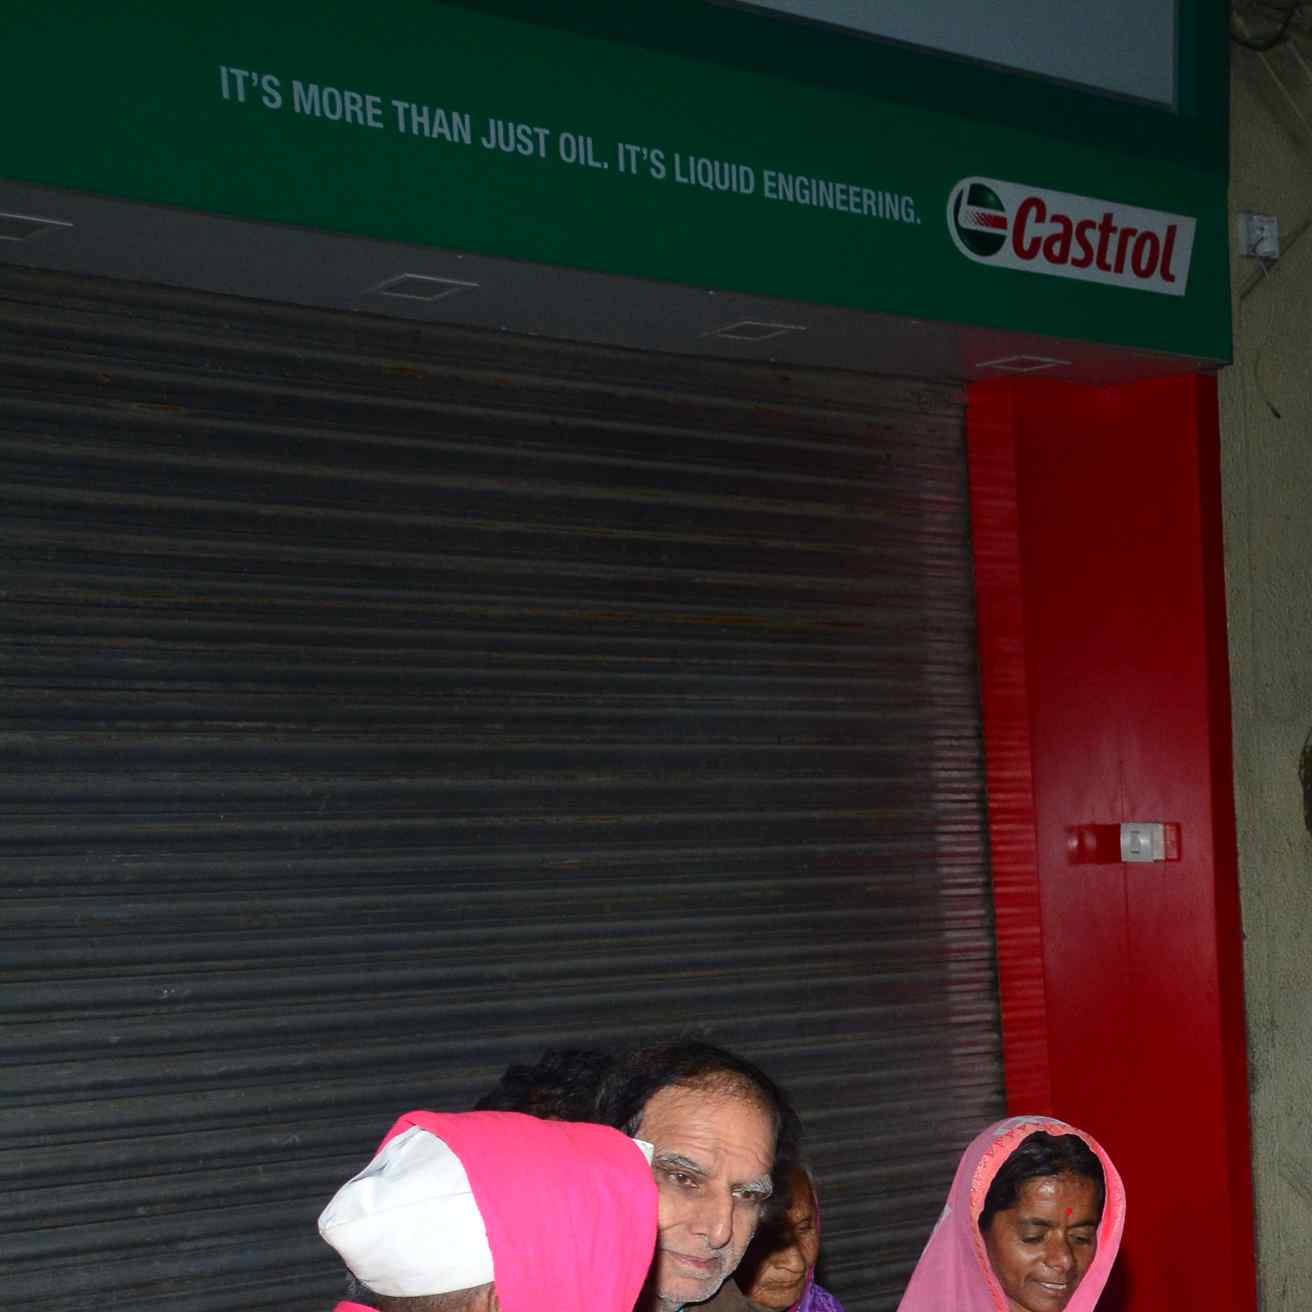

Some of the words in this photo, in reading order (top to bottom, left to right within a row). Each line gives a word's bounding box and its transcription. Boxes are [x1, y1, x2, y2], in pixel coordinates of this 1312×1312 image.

[291, 80, 384, 129] MORE
[391, 99, 472, 145] THAN
[481, 118, 549, 158] JUST
[559, 132, 608, 169] OIL.
[674, 153, 755, 195] LIQUID
[763, 169, 921, 225] ENGINEERING.
[1011, 196, 1178, 283] Castrol
